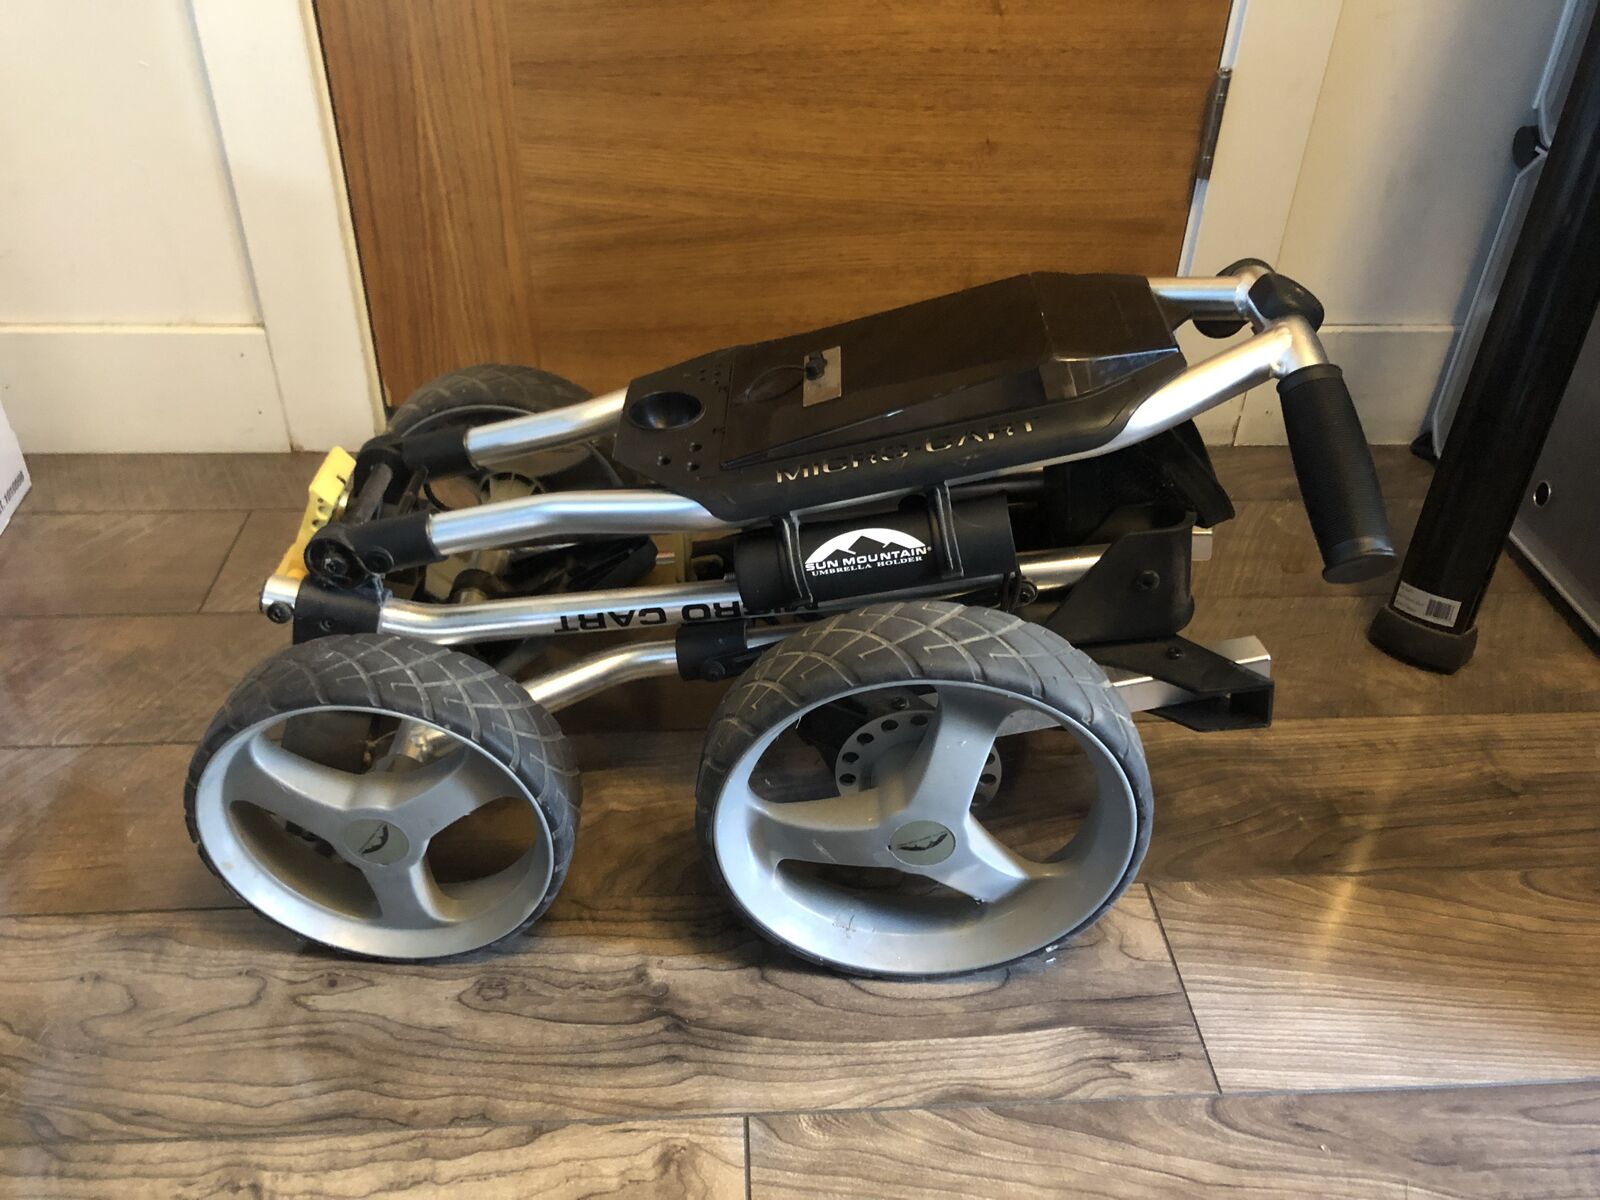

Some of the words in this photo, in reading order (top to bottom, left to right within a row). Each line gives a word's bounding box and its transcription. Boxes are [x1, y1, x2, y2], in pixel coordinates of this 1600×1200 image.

[925, 416, 1038, 452] CART
[804, 560, 839, 572] SUN
[842, 546, 928, 567] MOUNTAIN
[811, 563, 872, 577] UMBRELLA
[877, 555, 923, 568] HOLDER
[554, 607, 667, 633] CART
